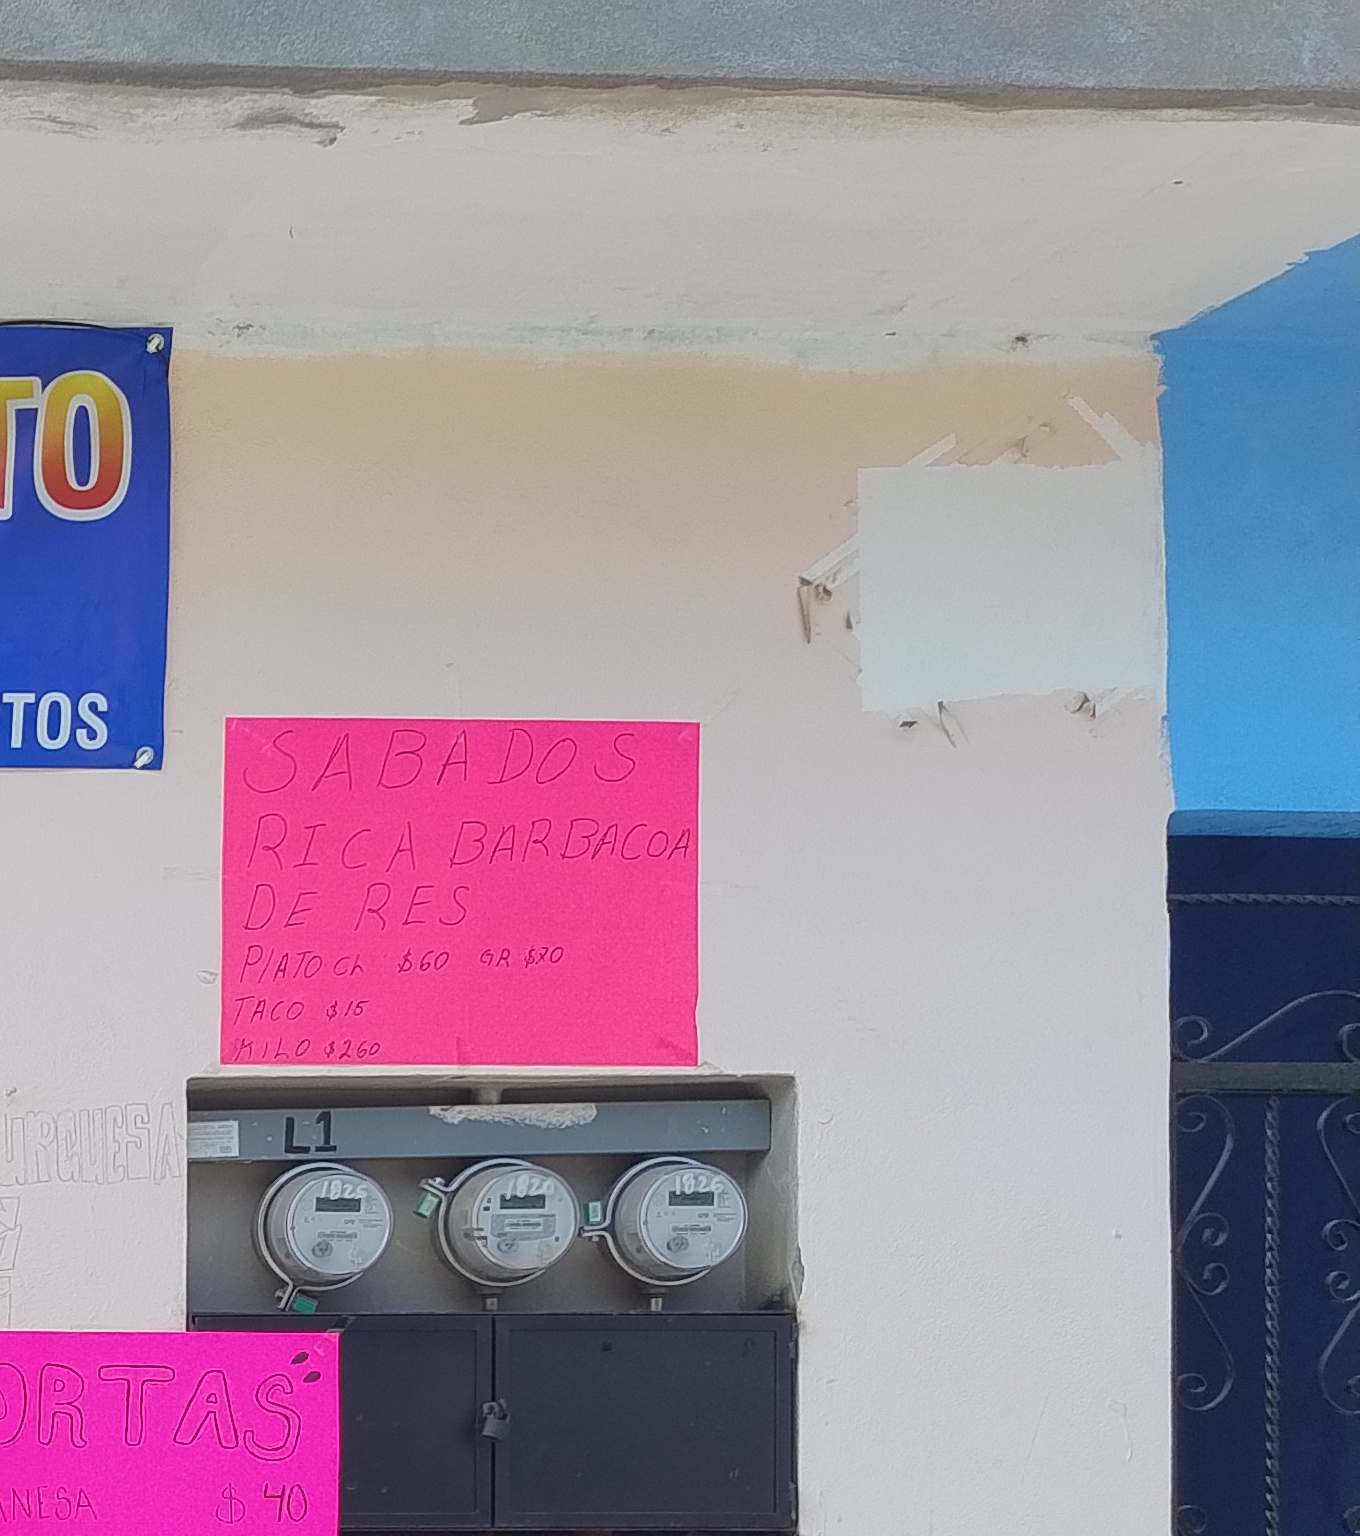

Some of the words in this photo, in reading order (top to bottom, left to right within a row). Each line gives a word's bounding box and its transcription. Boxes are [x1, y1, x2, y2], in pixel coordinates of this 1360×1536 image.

[240, 727, 638, 795] SABADOS
[245, 811, 419, 874] RICA
[447, 816, 692, 870] BARBACOA
[240, 882, 321, 933] DE
[352, 880, 474, 933] RES
[398, 948, 450, 974] $60
[479, 947, 511, 968] GR
[233, 996, 305, 1024] TACO
[326, 1000, 369, 1018] $15
[233, 1038, 311, 1062] KILO
[323, 1040, 382, 1060] $260
[284, 1111, 338, 1154] L1
